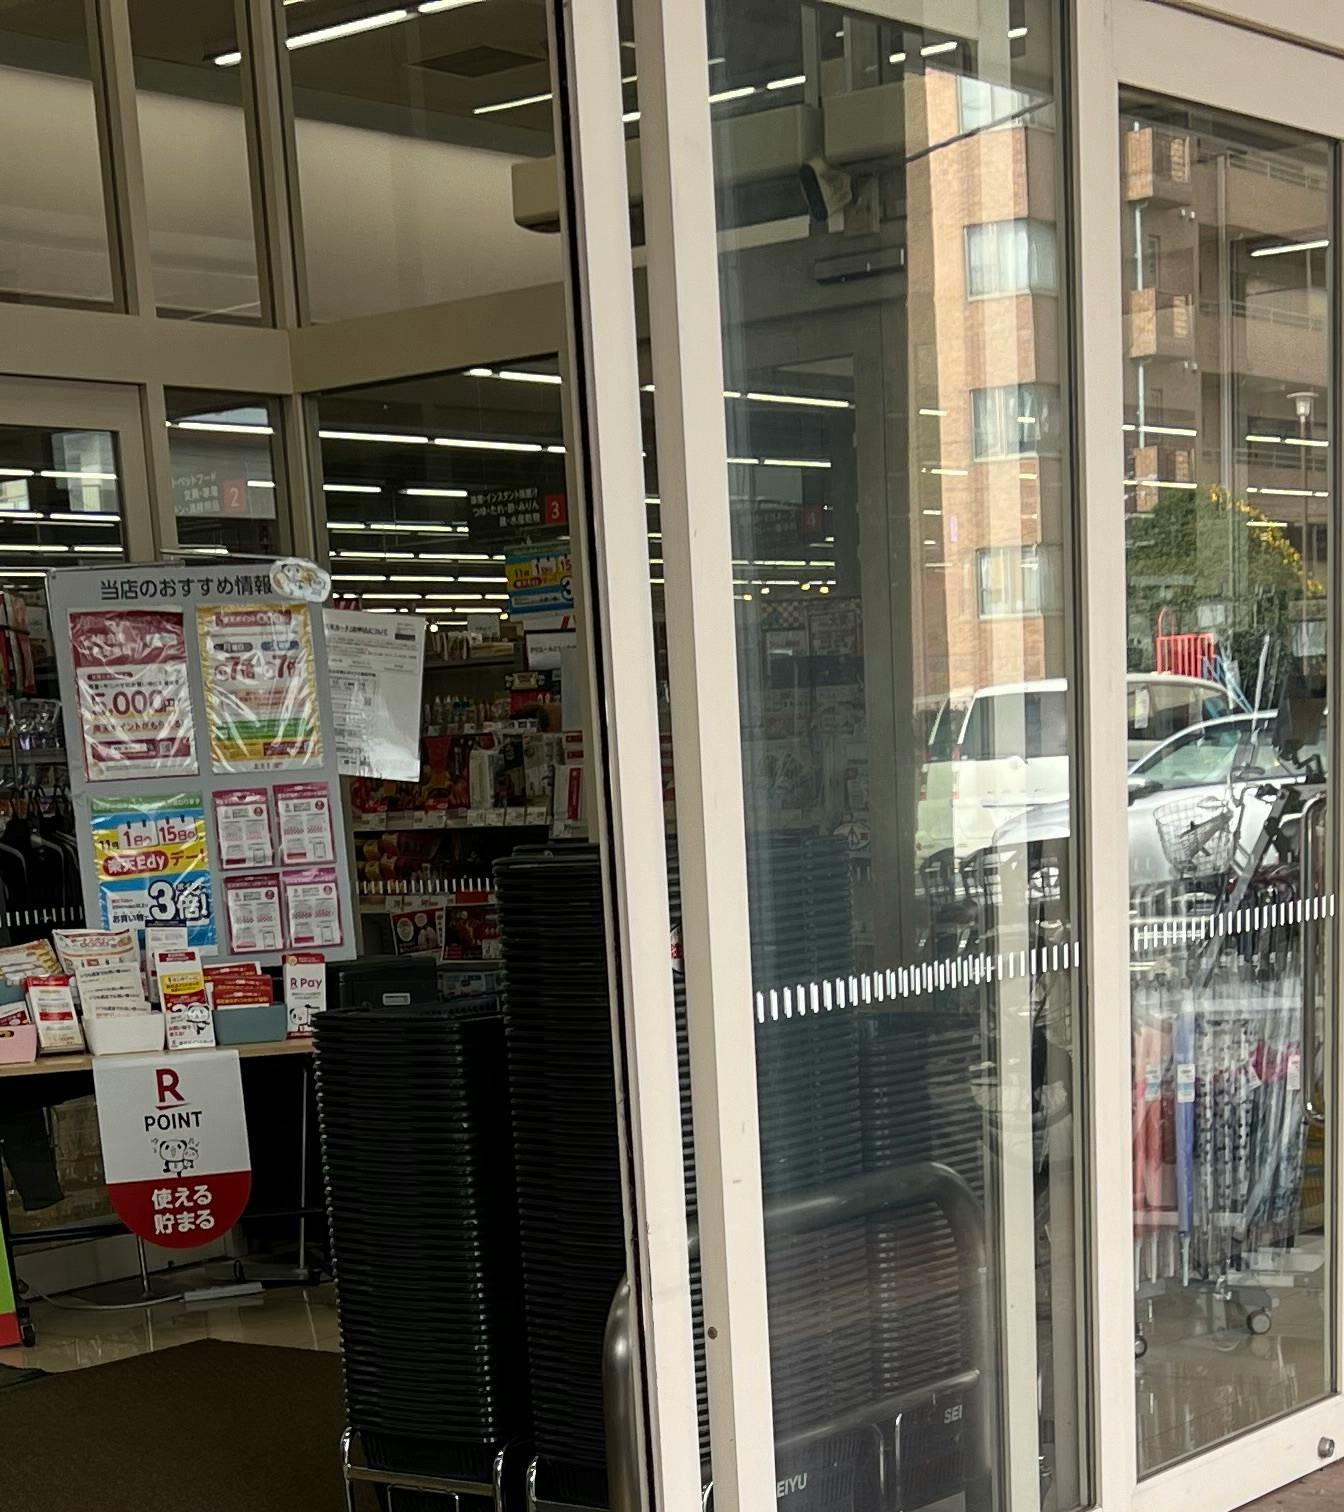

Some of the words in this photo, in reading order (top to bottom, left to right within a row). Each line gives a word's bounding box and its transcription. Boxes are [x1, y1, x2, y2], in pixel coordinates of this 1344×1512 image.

[229, 487, 241, 507] 2
[551, 501, 561, 520] 3
[100, 576, 274, 601] 当店のおすすめ情報
[107, 854, 166, 875] 楽天Edy
[300, 977, 323, 991] Pay
[155, 1068, 188, 1109] R
[144, 1110, 203, 1132] POINT
[151, 1184, 213, 1211] 使える
[153, 1209, 215, 1235] 貯まる
[943, 1404, 964, 1424] SEI
[776, 1472, 808, 1498] EIYU
